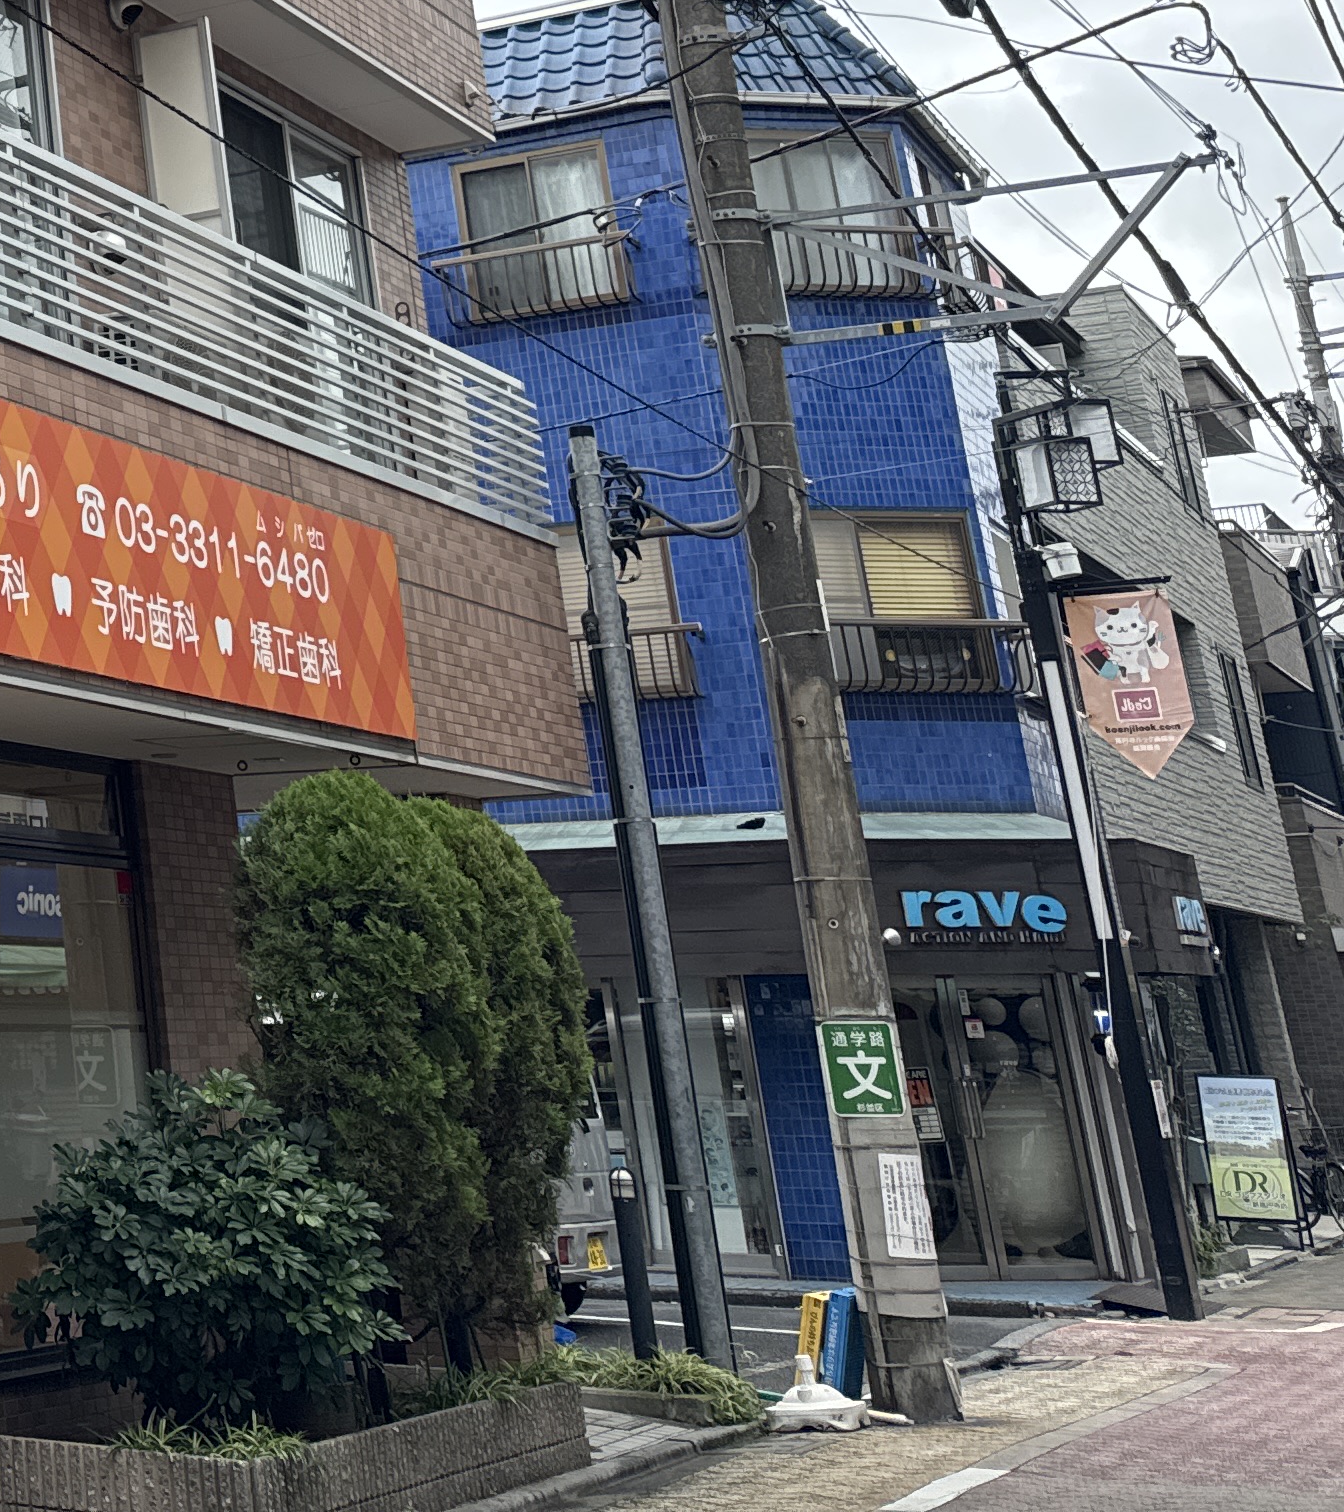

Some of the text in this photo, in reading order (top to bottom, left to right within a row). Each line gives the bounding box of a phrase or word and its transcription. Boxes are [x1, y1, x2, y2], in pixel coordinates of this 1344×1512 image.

[114, 496, 330, 604] 03-3311-6480
[90, 577, 200, 657] 予防歯科
[250, 618, 342, 690] 矯正歯科
[900, 890, 1067, 933] rave
[830, 1031, 885, 1047] 通学路
[836, 1050, 893, 1100] 文
